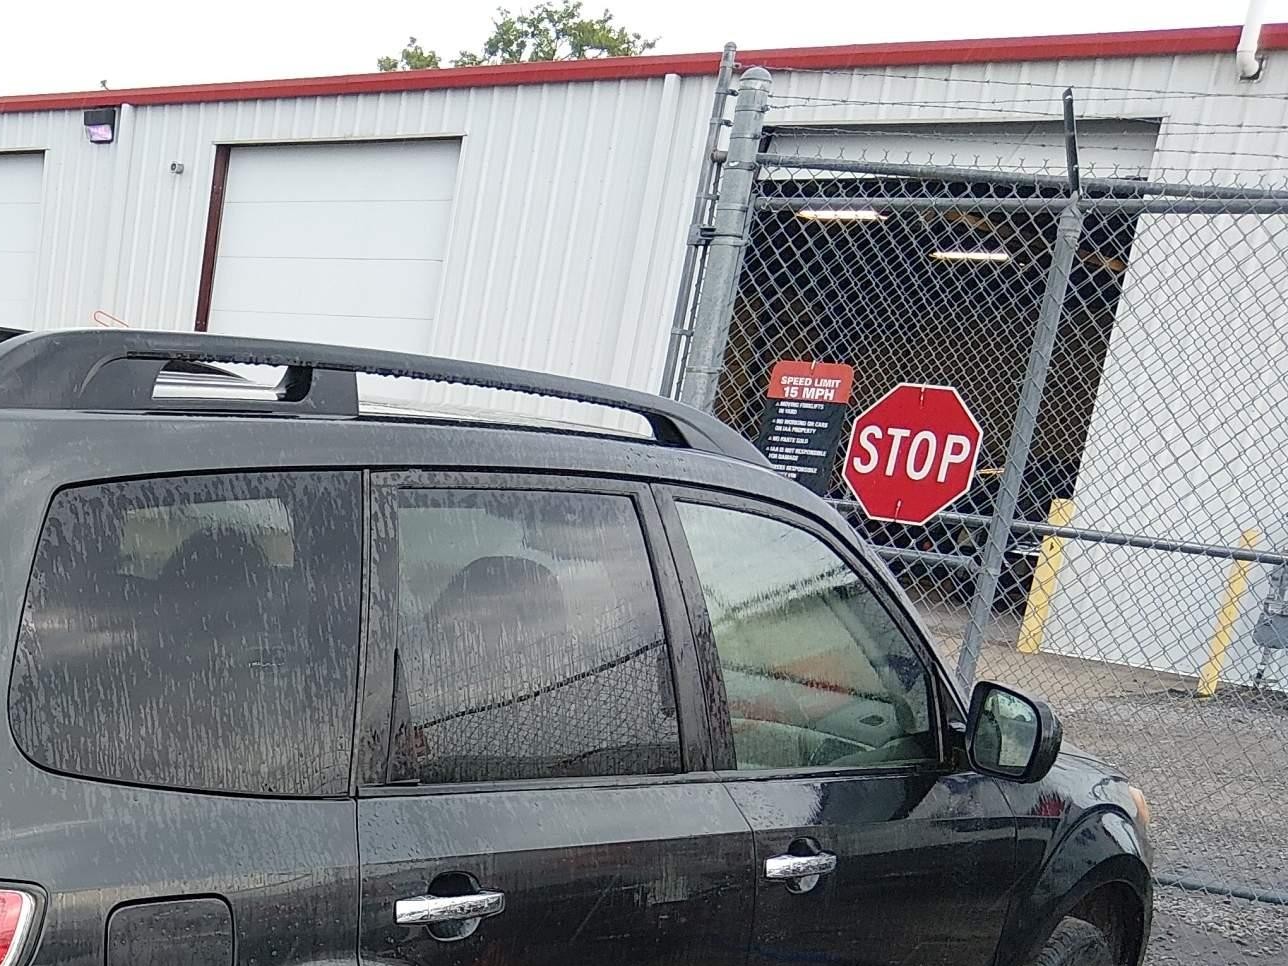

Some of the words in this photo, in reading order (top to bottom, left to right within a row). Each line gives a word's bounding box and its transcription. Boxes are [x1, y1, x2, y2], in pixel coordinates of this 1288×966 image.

[781, 376, 812, 386] SPEED
[814, 378, 841, 388] LIMIT
[783, 387, 798, 397] 15
[802, 388, 835, 400] MPH
[792, 426, 816, 434] PROPERTY
[853, 425, 971, 483] STOP
